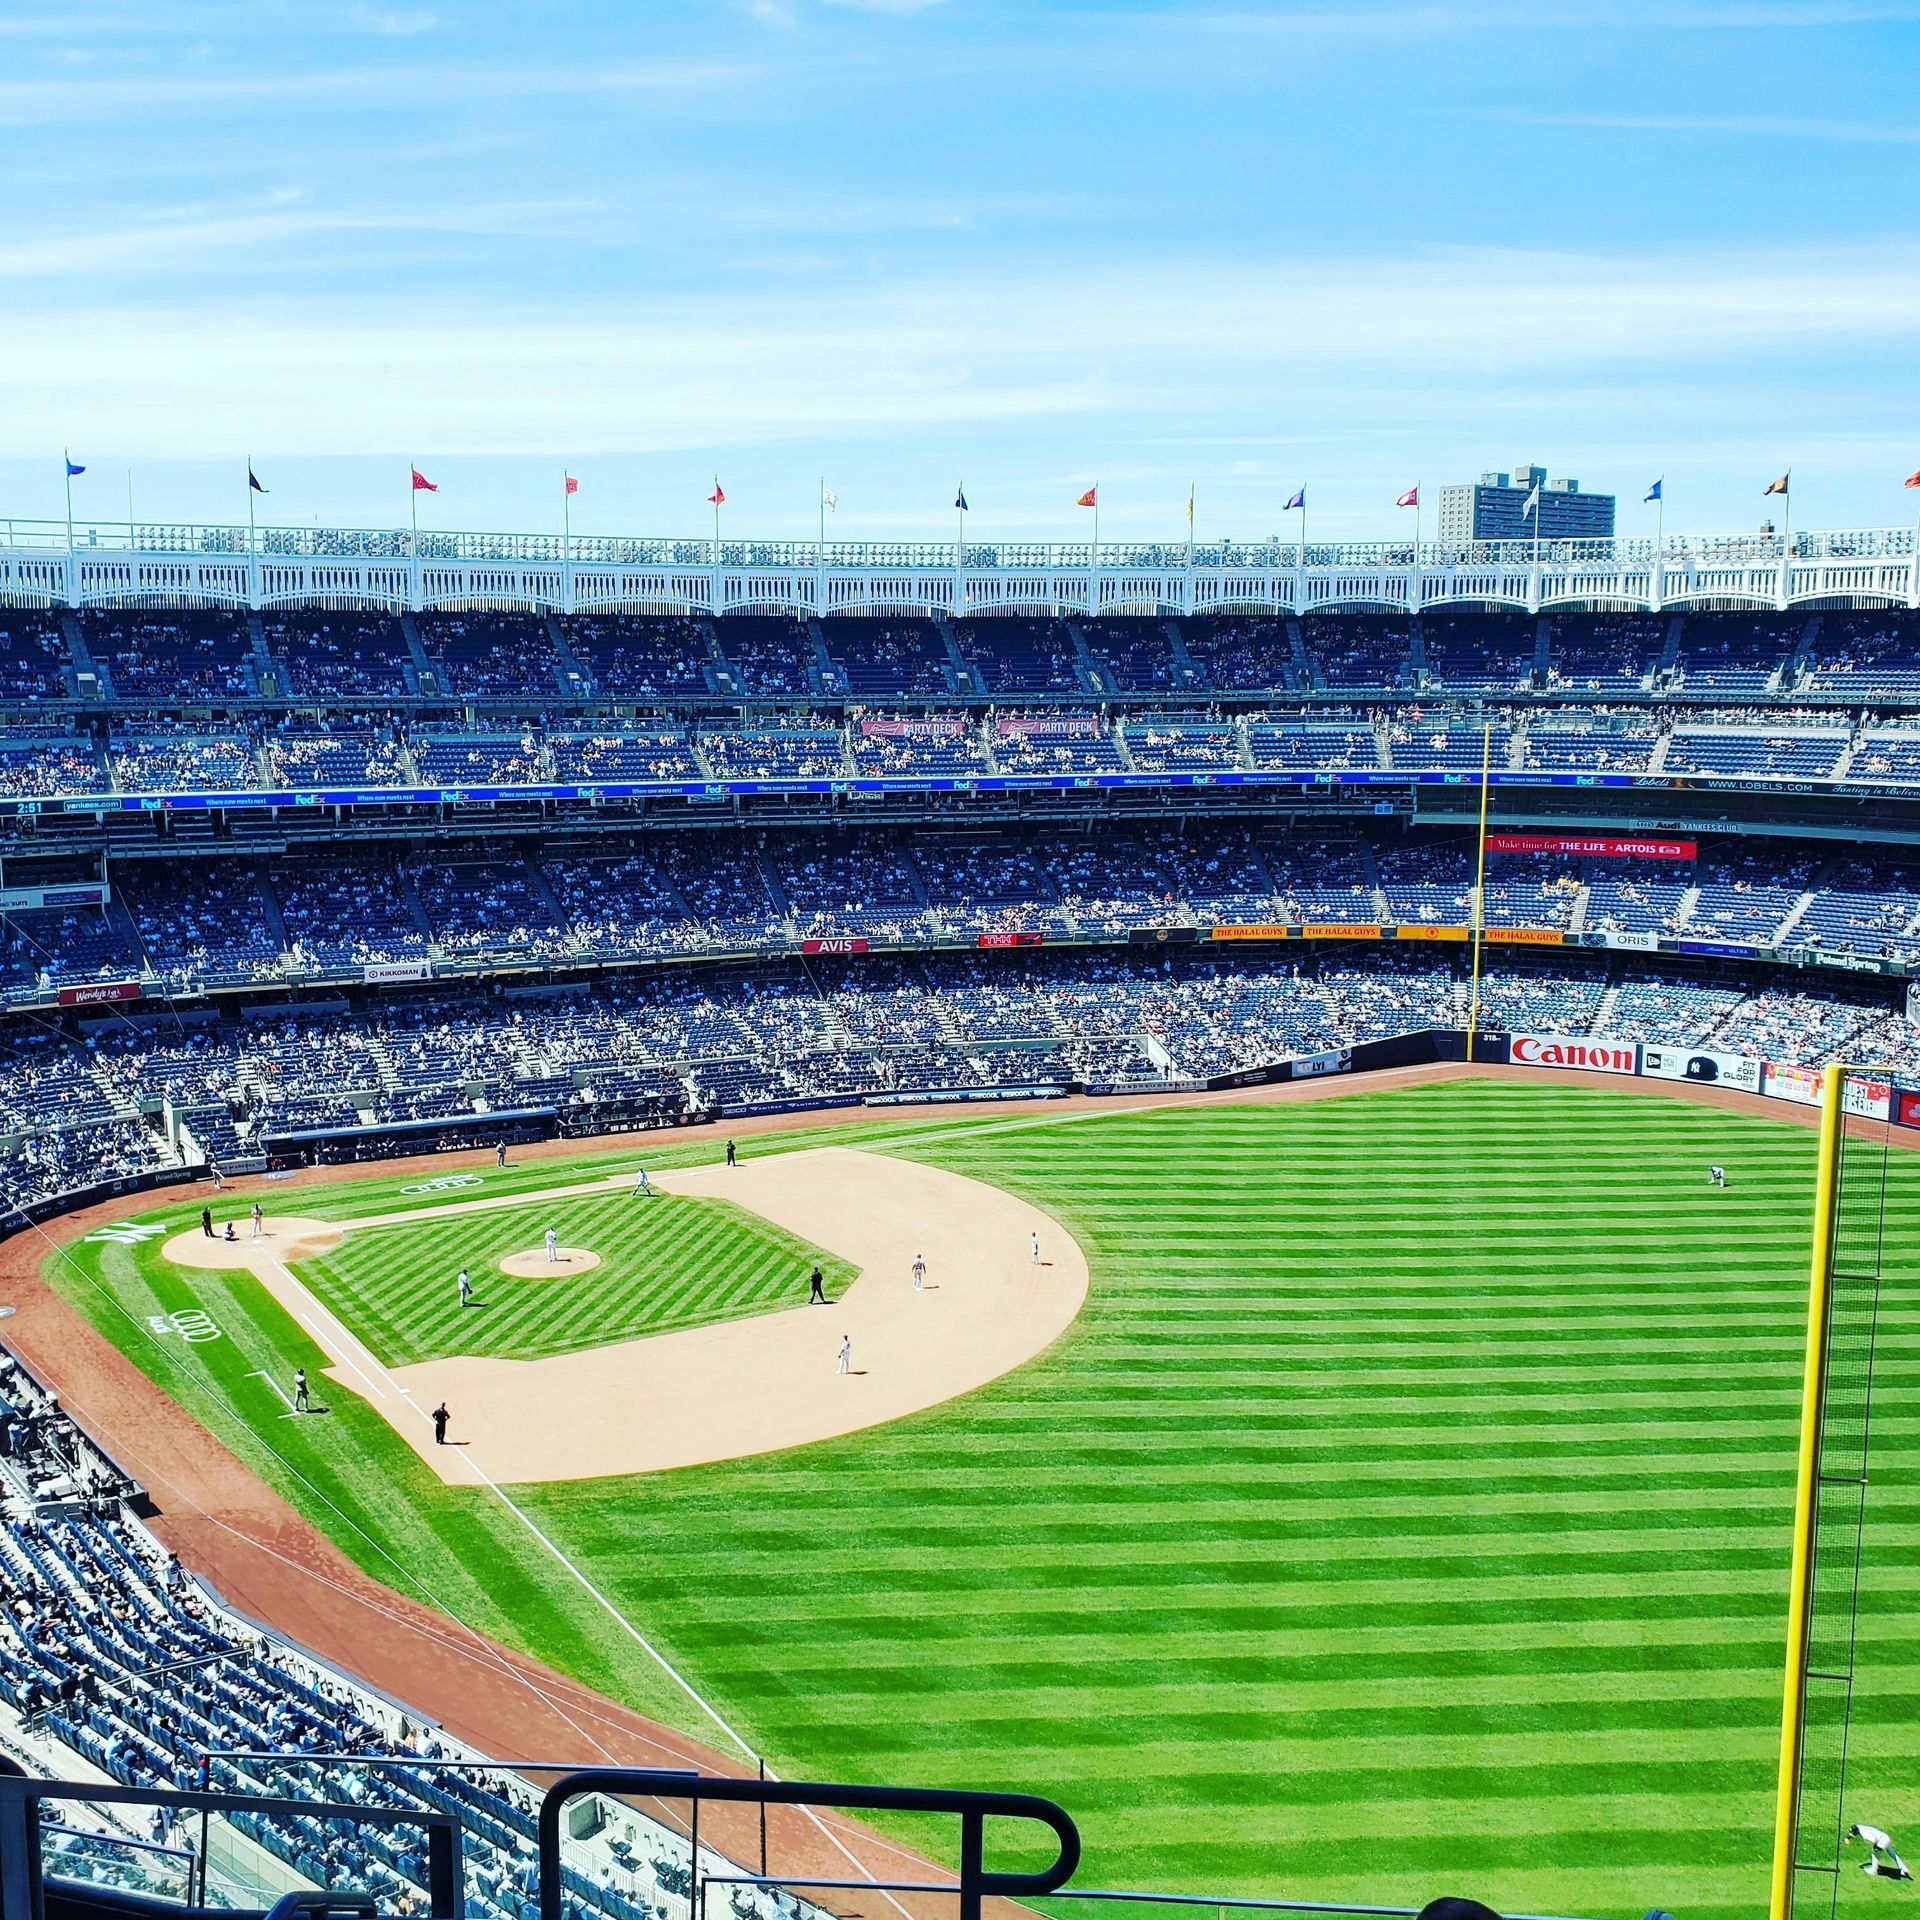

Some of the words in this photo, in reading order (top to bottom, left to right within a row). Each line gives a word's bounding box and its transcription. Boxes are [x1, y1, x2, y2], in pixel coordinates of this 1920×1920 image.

[933, 723, 958, 734] DECK
[1040, 722, 1068, 732] PARTY
[1070, 722, 1092, 732] DECK
[1074, 778, 1099, 787] FedEx
[1192, 776, 1216, 784] FedEx
[1315, 774, 1342, 782] FedEx
[1444, 774, 1472, 783] FedEx
[1576, 776, 1604, 785] FedEx
[706, 785, 730, 794] FedEx
[831, 782, 856, 792] FedEx
[954, 780, 978, 790] FedEx
[1708, 780, 1812, 792] WWW.LOBELS.COM
[1832, 784, 1870, 796] Tasting
[441, 791, 469, 800] FedEx
[578, 788, 604, 797] FedEx
[141, 799, 172, 809] FedEx
[296, 794, 326, 804] FedEx
[18, 803, 42, 814] 2:51
[66, 802, 119, 811] yankees.com
[1498, 840, 1520, 848] Make
[1522, 841, 1542, 849] time
[1542, 841, 1557, 850] for
[1560, 842, 1582, 850] THE
[1584, 842, 1606, 852] LIFE
[1615, 844, 1656, 854] ARTOIS
[1234, 928, 1260, 936] HALAL
[1262, 928, 1283, 936] GUYS
[1325, 928, 1353, 936] HALAL
[1354, 928, 1376, 936] GUYS
[1488, 931, 1508, 939] THE
[1510, 932, 1536, 940] HALAL
[1537, 933, 1559, 942] GUYS
[984, 934, 1012, 944] THK
[1617, 935, 1649, 946] ORIS
[818, 940, 852, 952] AVIS
[1816, 954, 1848, 966] Poland
[1848, 958, 1880, 972] Spring
[380, 968, 418, 977] KIKKOMAN
[76, 988, 106, 1002] Wendy's
[1512, 1038, 1632, 1070] Canon
[1743, 1061, 1756, 1069] FIT
[1737, 1067, 1756, 1076] FOR
[1723, 1072, 1755, 1084] GLORY
